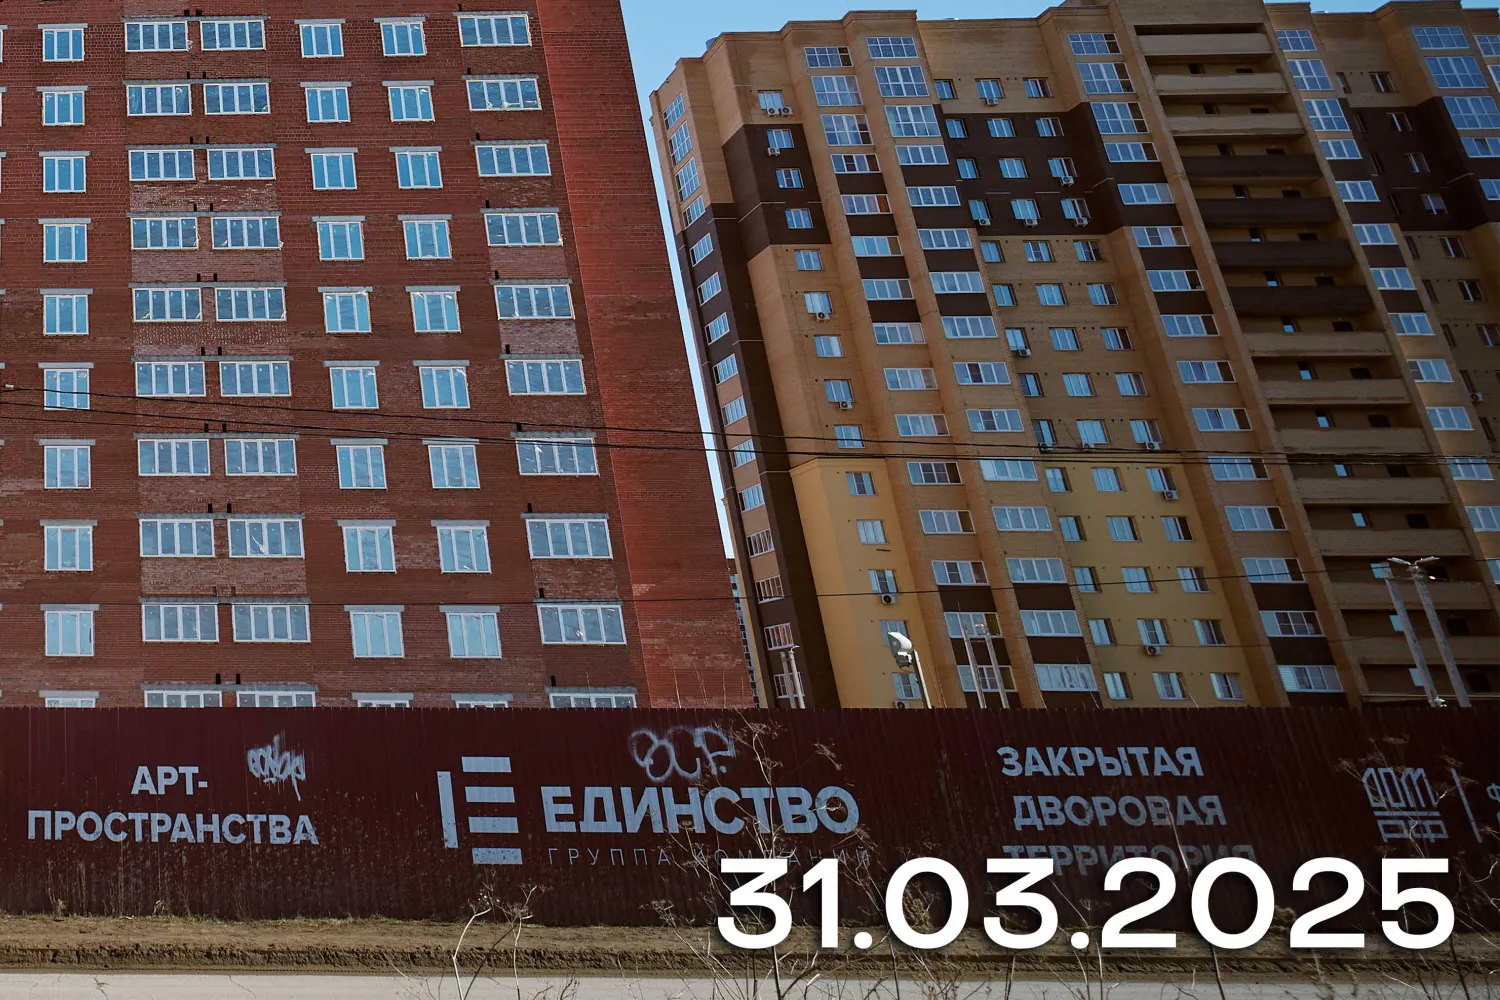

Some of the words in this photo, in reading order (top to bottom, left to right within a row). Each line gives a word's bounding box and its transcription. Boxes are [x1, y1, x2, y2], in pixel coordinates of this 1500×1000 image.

[997, 746, 1203, 777] ЗАКРЫТАЯ
[131, 765, 208, 795] АРТ-
[541, 786, 860, 834] ЕДИНСТВО
[1013, 795, 1227, 831] ДВОРОВАЯ
[28, 810, 319, 845] ПРОСТРАНСТВА
[548, 848, 672, 866] ГРУППА
